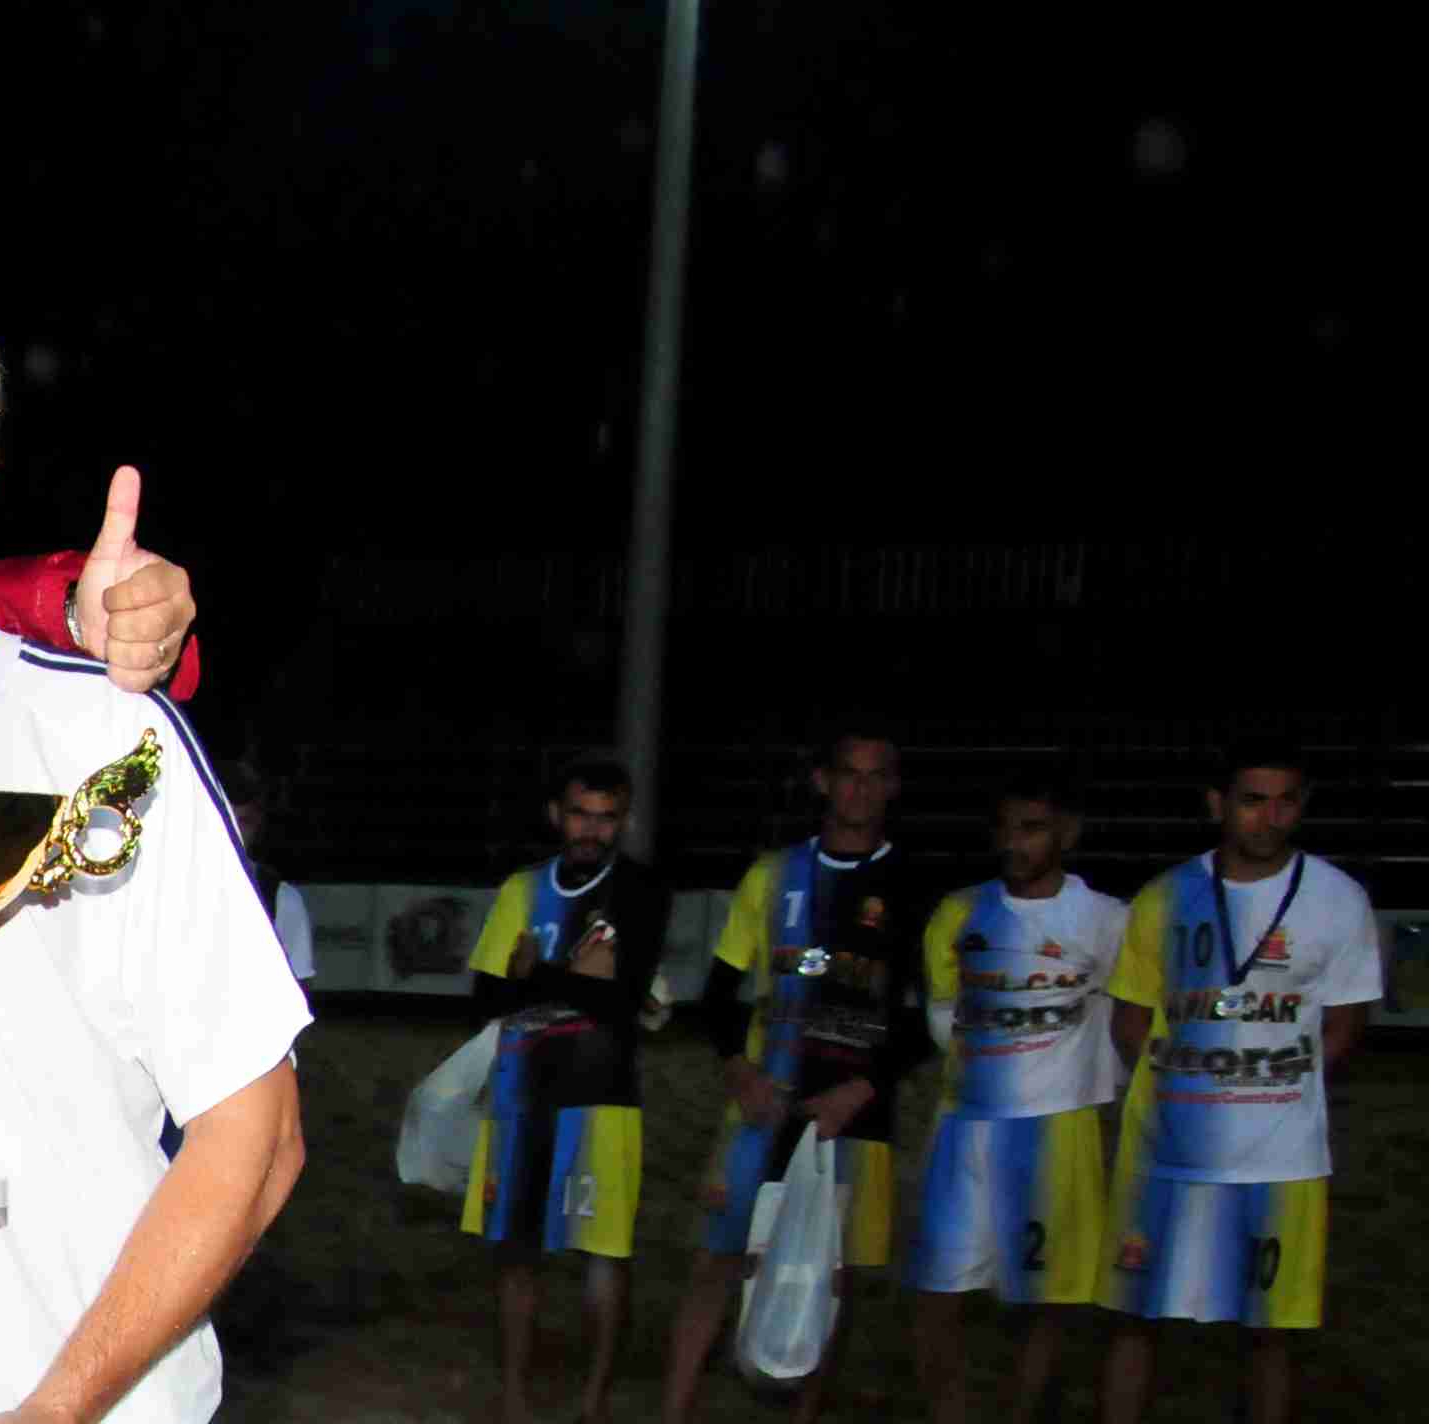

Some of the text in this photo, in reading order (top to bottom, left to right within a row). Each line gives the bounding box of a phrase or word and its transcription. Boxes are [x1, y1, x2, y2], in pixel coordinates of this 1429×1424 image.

[784, 890, 805, 928] 1
[1171, 922, 1214, 967] 10
[562, 1176, 597, 1217] 12
[1021, 1220, 1046, 1271] 2
